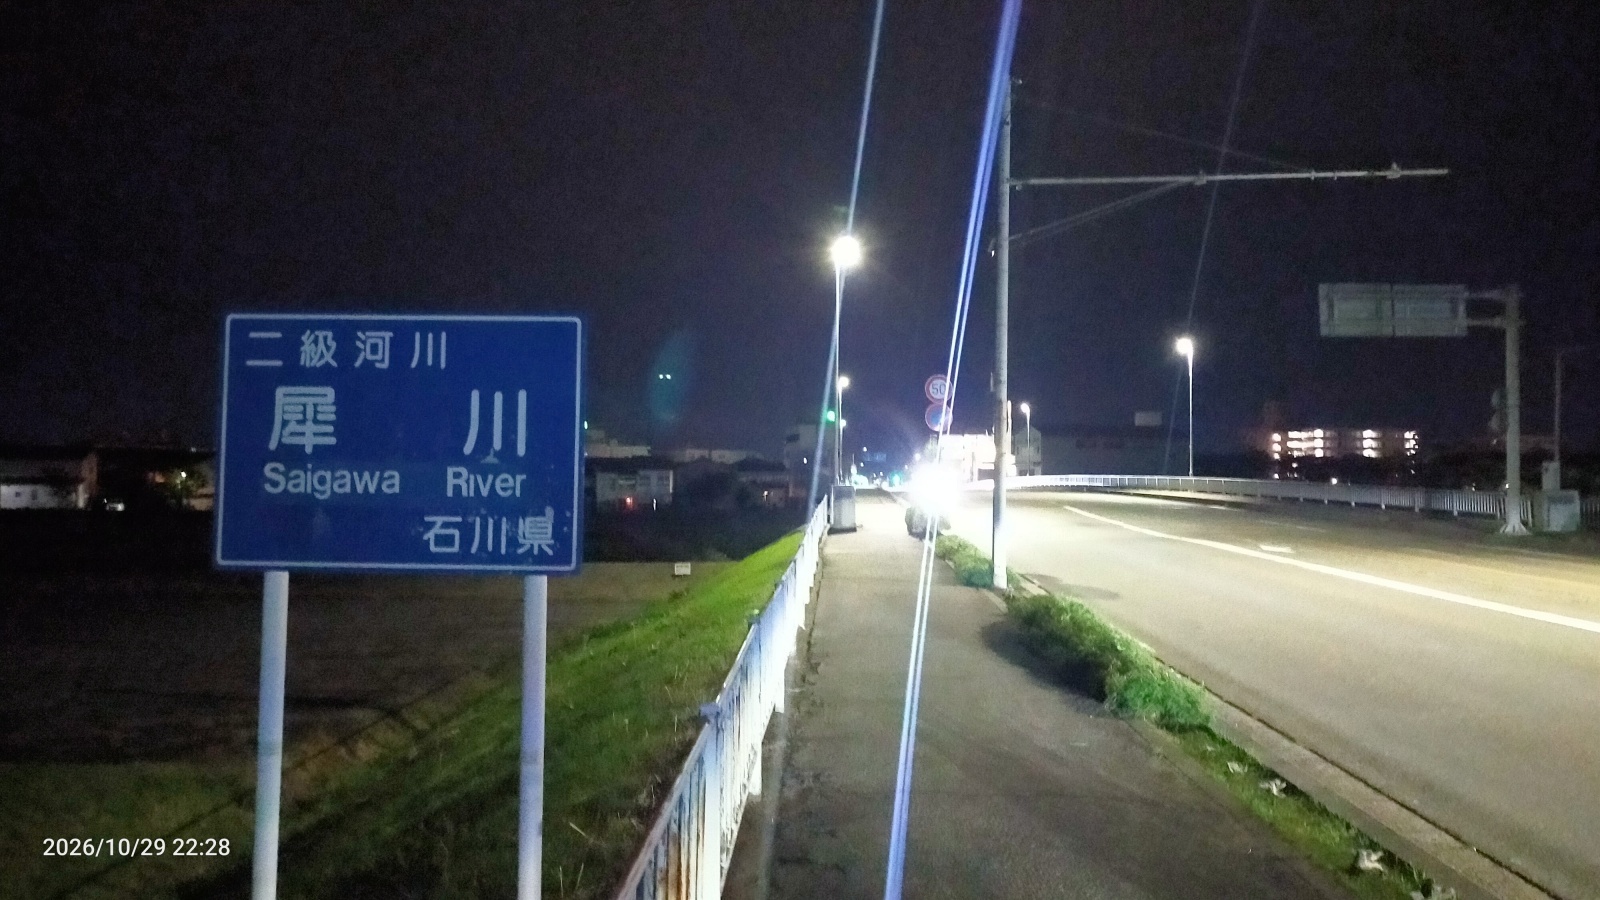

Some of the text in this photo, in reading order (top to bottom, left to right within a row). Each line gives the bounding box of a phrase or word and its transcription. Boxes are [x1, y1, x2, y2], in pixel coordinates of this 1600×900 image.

[246, 329, 447, 370] 二級河川
[263, 462, 527, 500] Saigawa River
[422, 514, 555, 556] 石川県
